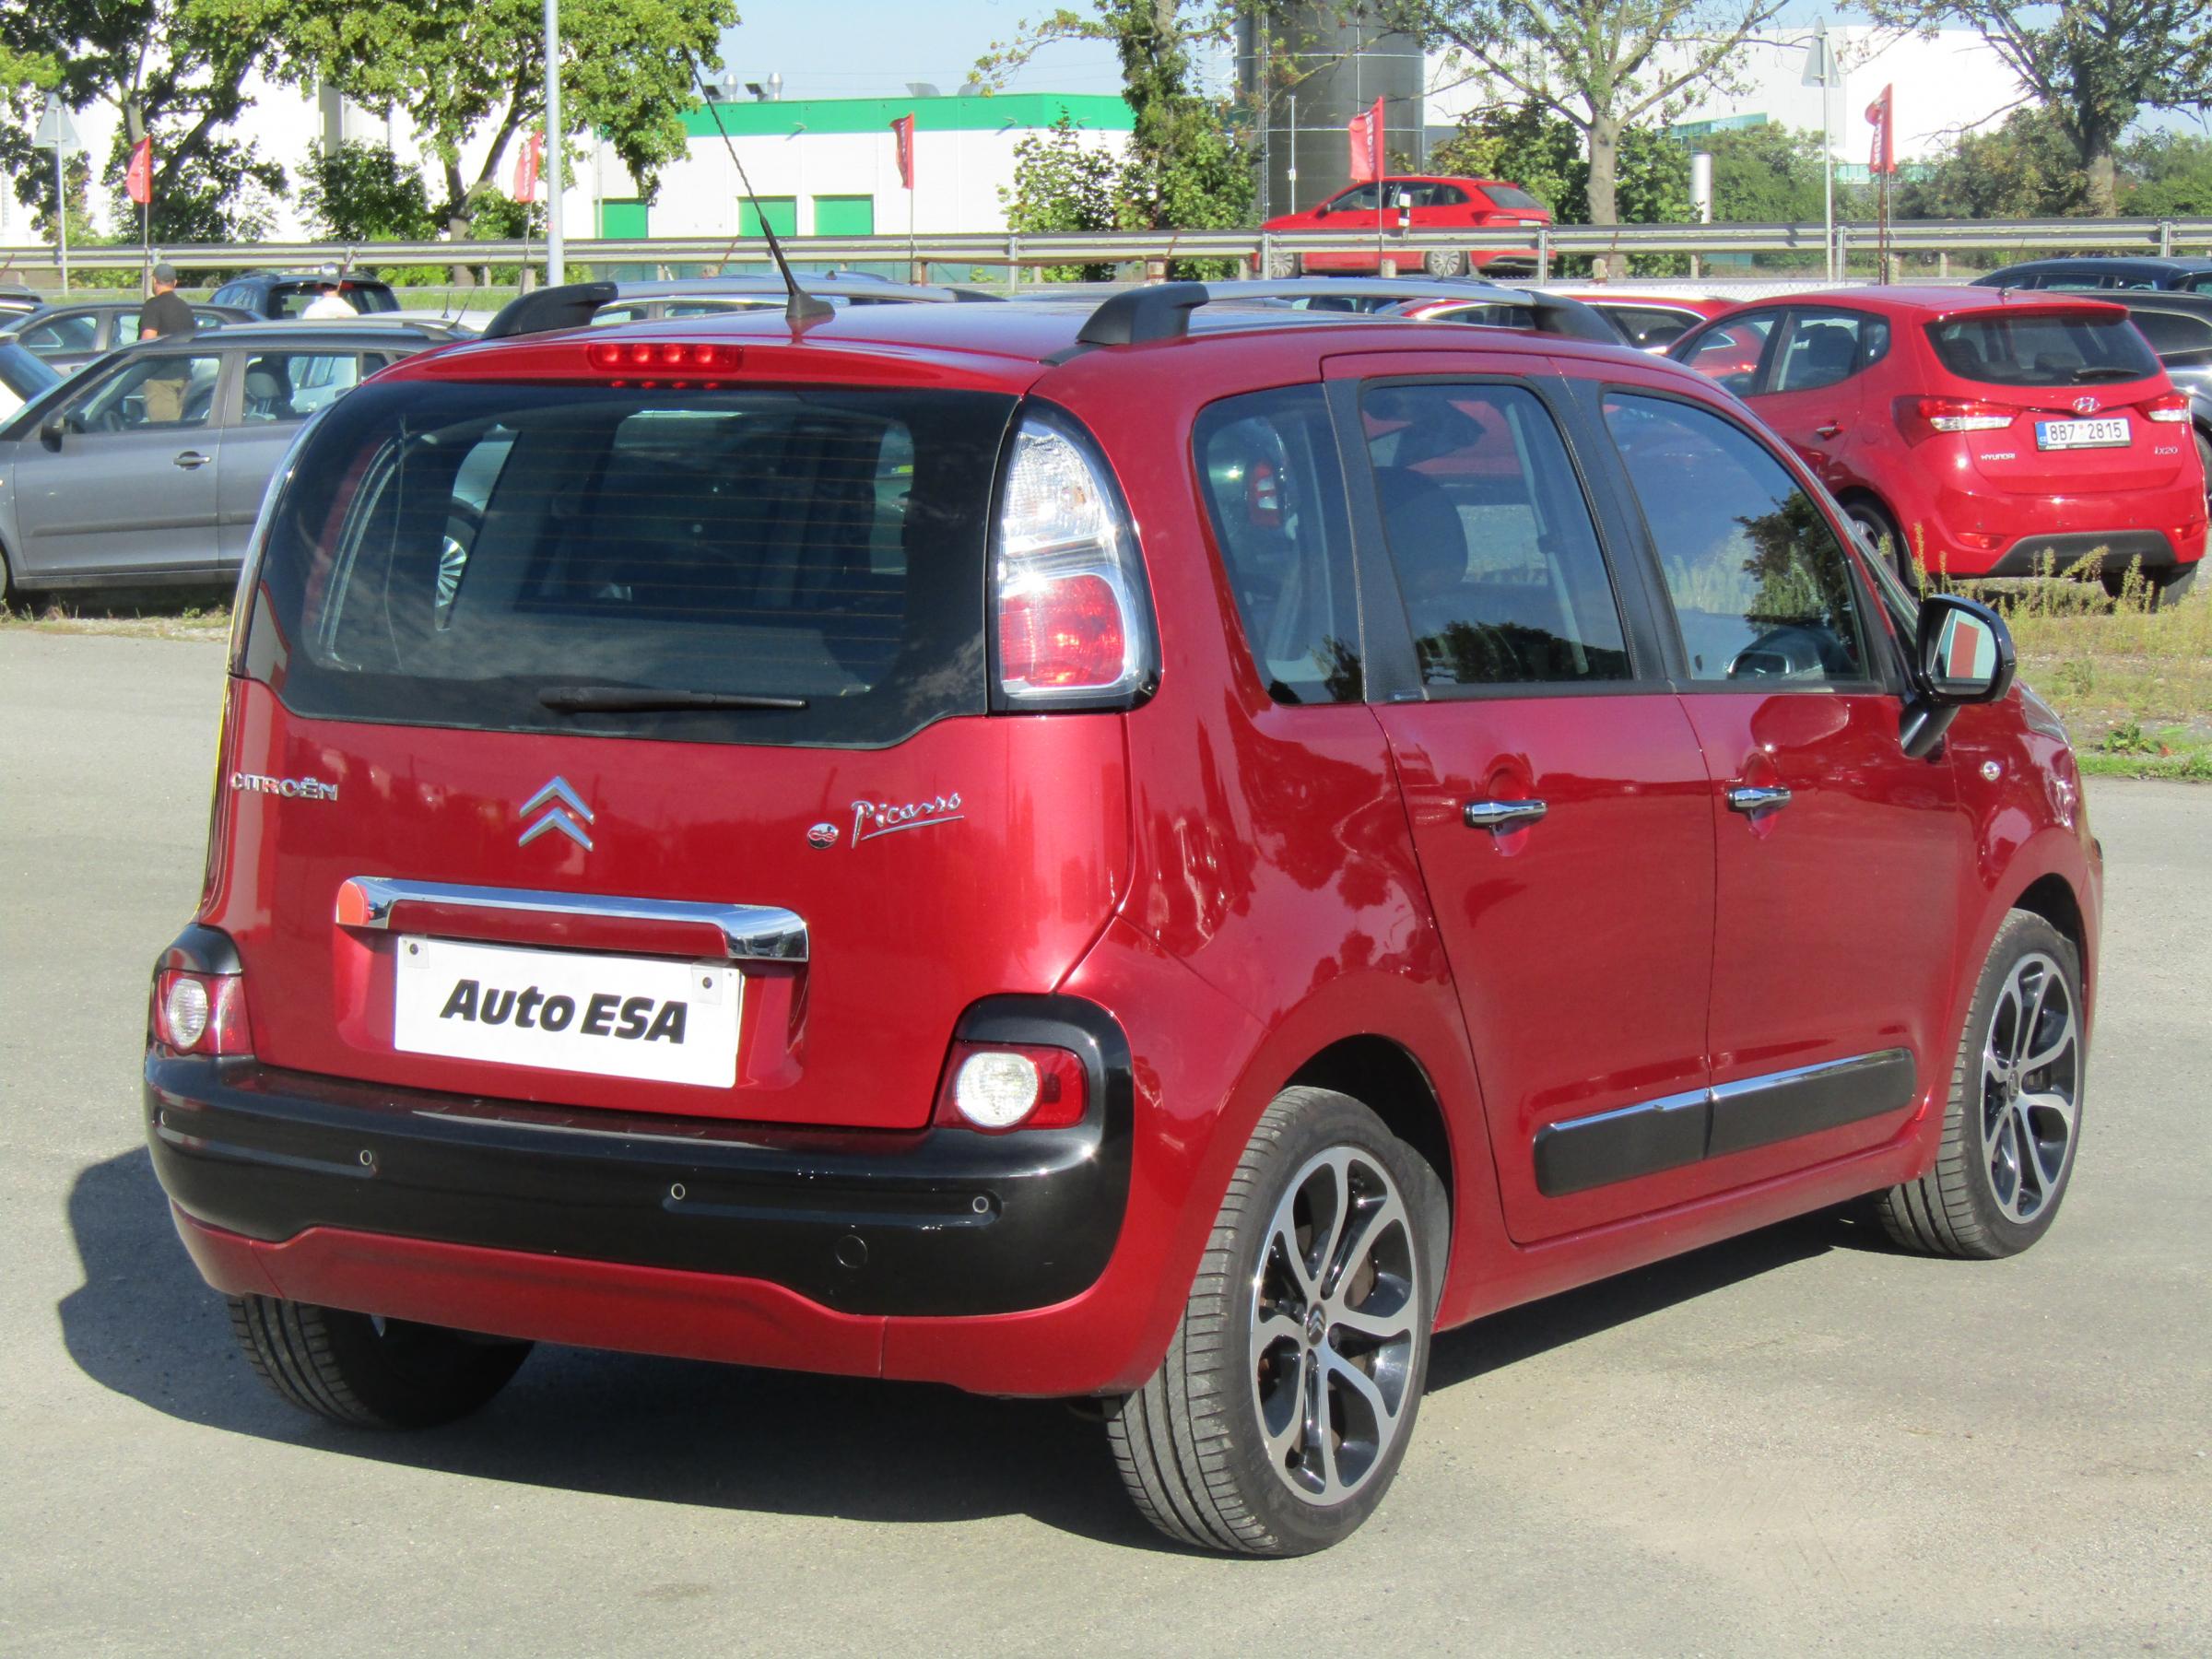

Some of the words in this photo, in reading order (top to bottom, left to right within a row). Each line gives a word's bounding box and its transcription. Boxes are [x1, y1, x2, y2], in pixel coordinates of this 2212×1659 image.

[2050, 424, 2075, 441] 8B7
[2087, 422, 2122, 440] 2815
[1981, 453, 2016, 461] HYUNDAI
[231, 771, 338, 801] CITROËN
[851, 793, 961, 849] Picasso
[439, 979, 575, 1032] Auto
[580, 993, 688, 1044] ESA
